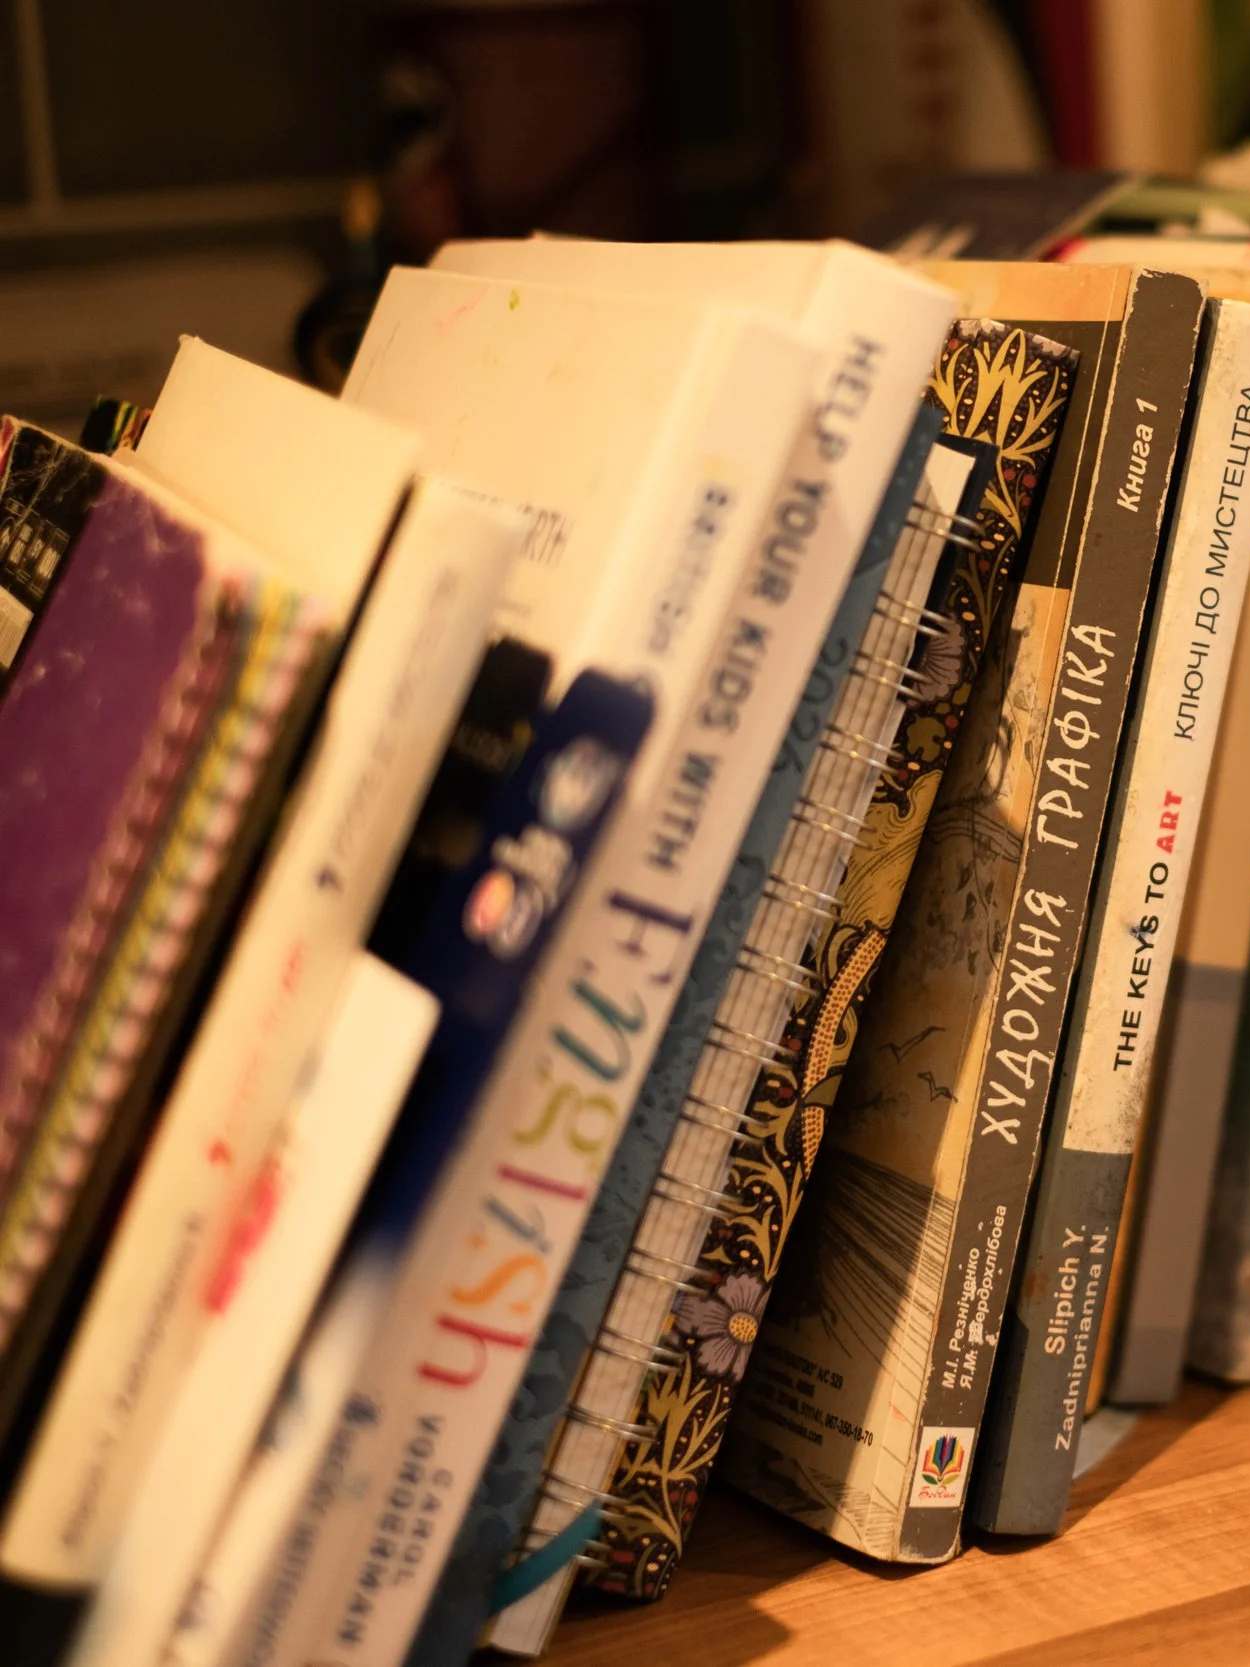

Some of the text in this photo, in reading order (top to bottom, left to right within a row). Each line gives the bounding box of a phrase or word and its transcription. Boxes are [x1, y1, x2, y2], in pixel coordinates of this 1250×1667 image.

[808, 332, 888, 470] HELP
[745, 478, 833, 610] YOUR
[700, 613, 772, 739] KIDS
[1174, 640, 1210, 742] КЛЮЧІ
[1193, 585, 1221, 635] ДО
[641, 754, 722, 877] WITH
[981, 398, 1158, 1146] ХУДОЖНЯ ГРАФІКА Книга 1
[1112, 790, 1184, 1072] THE KEYS TO ART
[949, 1247, 980, 1352] Резніченко
[968, 1204, 1007, 1345] вердохлібова
[1044, 1223, 1087, 1355] Slipich Y.
[1054, 1225, 1110, 1451] Zadniprianna N.
[825, 1413, 873, 1446] 067-350-18-70
